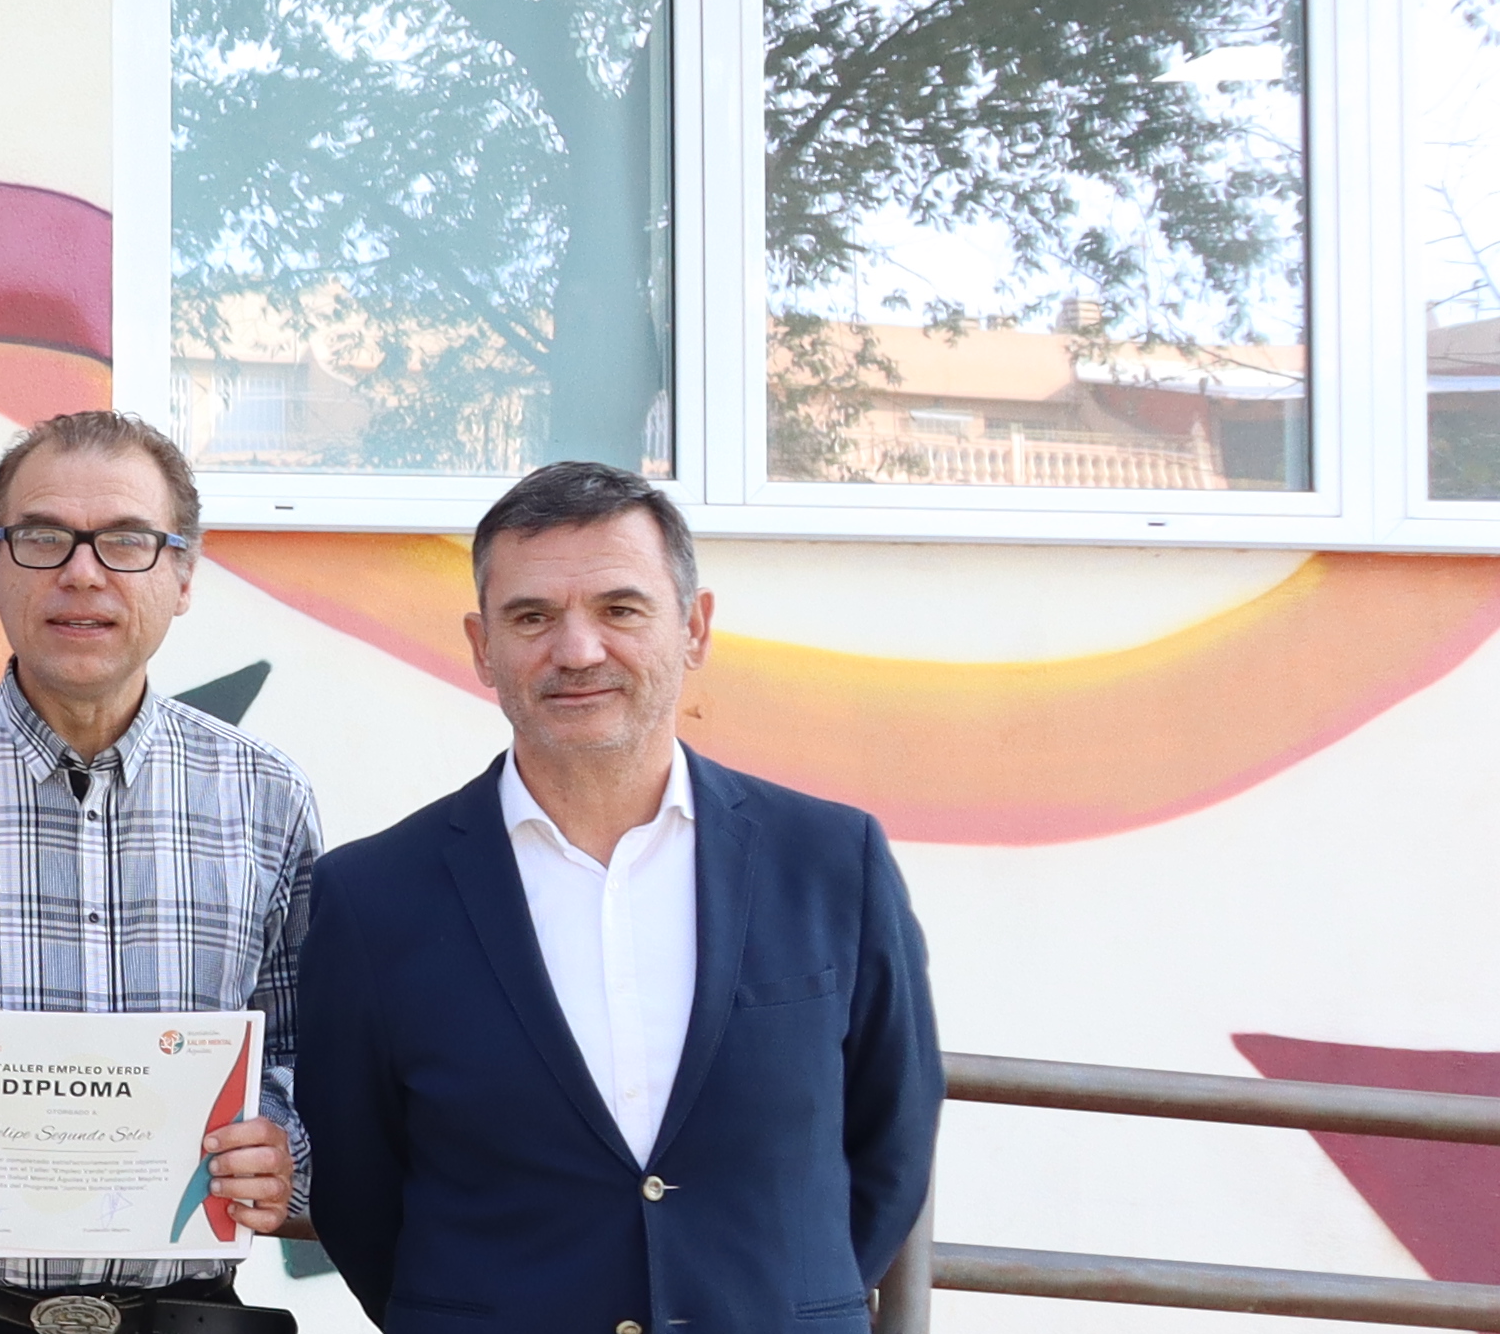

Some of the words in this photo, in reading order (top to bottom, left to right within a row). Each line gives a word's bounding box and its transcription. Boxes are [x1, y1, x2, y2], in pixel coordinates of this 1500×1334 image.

[48, 1064, 102, 1075] EMPLEO
[107, 1065, 150, 1076] VERDE
[2, 1079, 133, 1098] DIPLOMA
